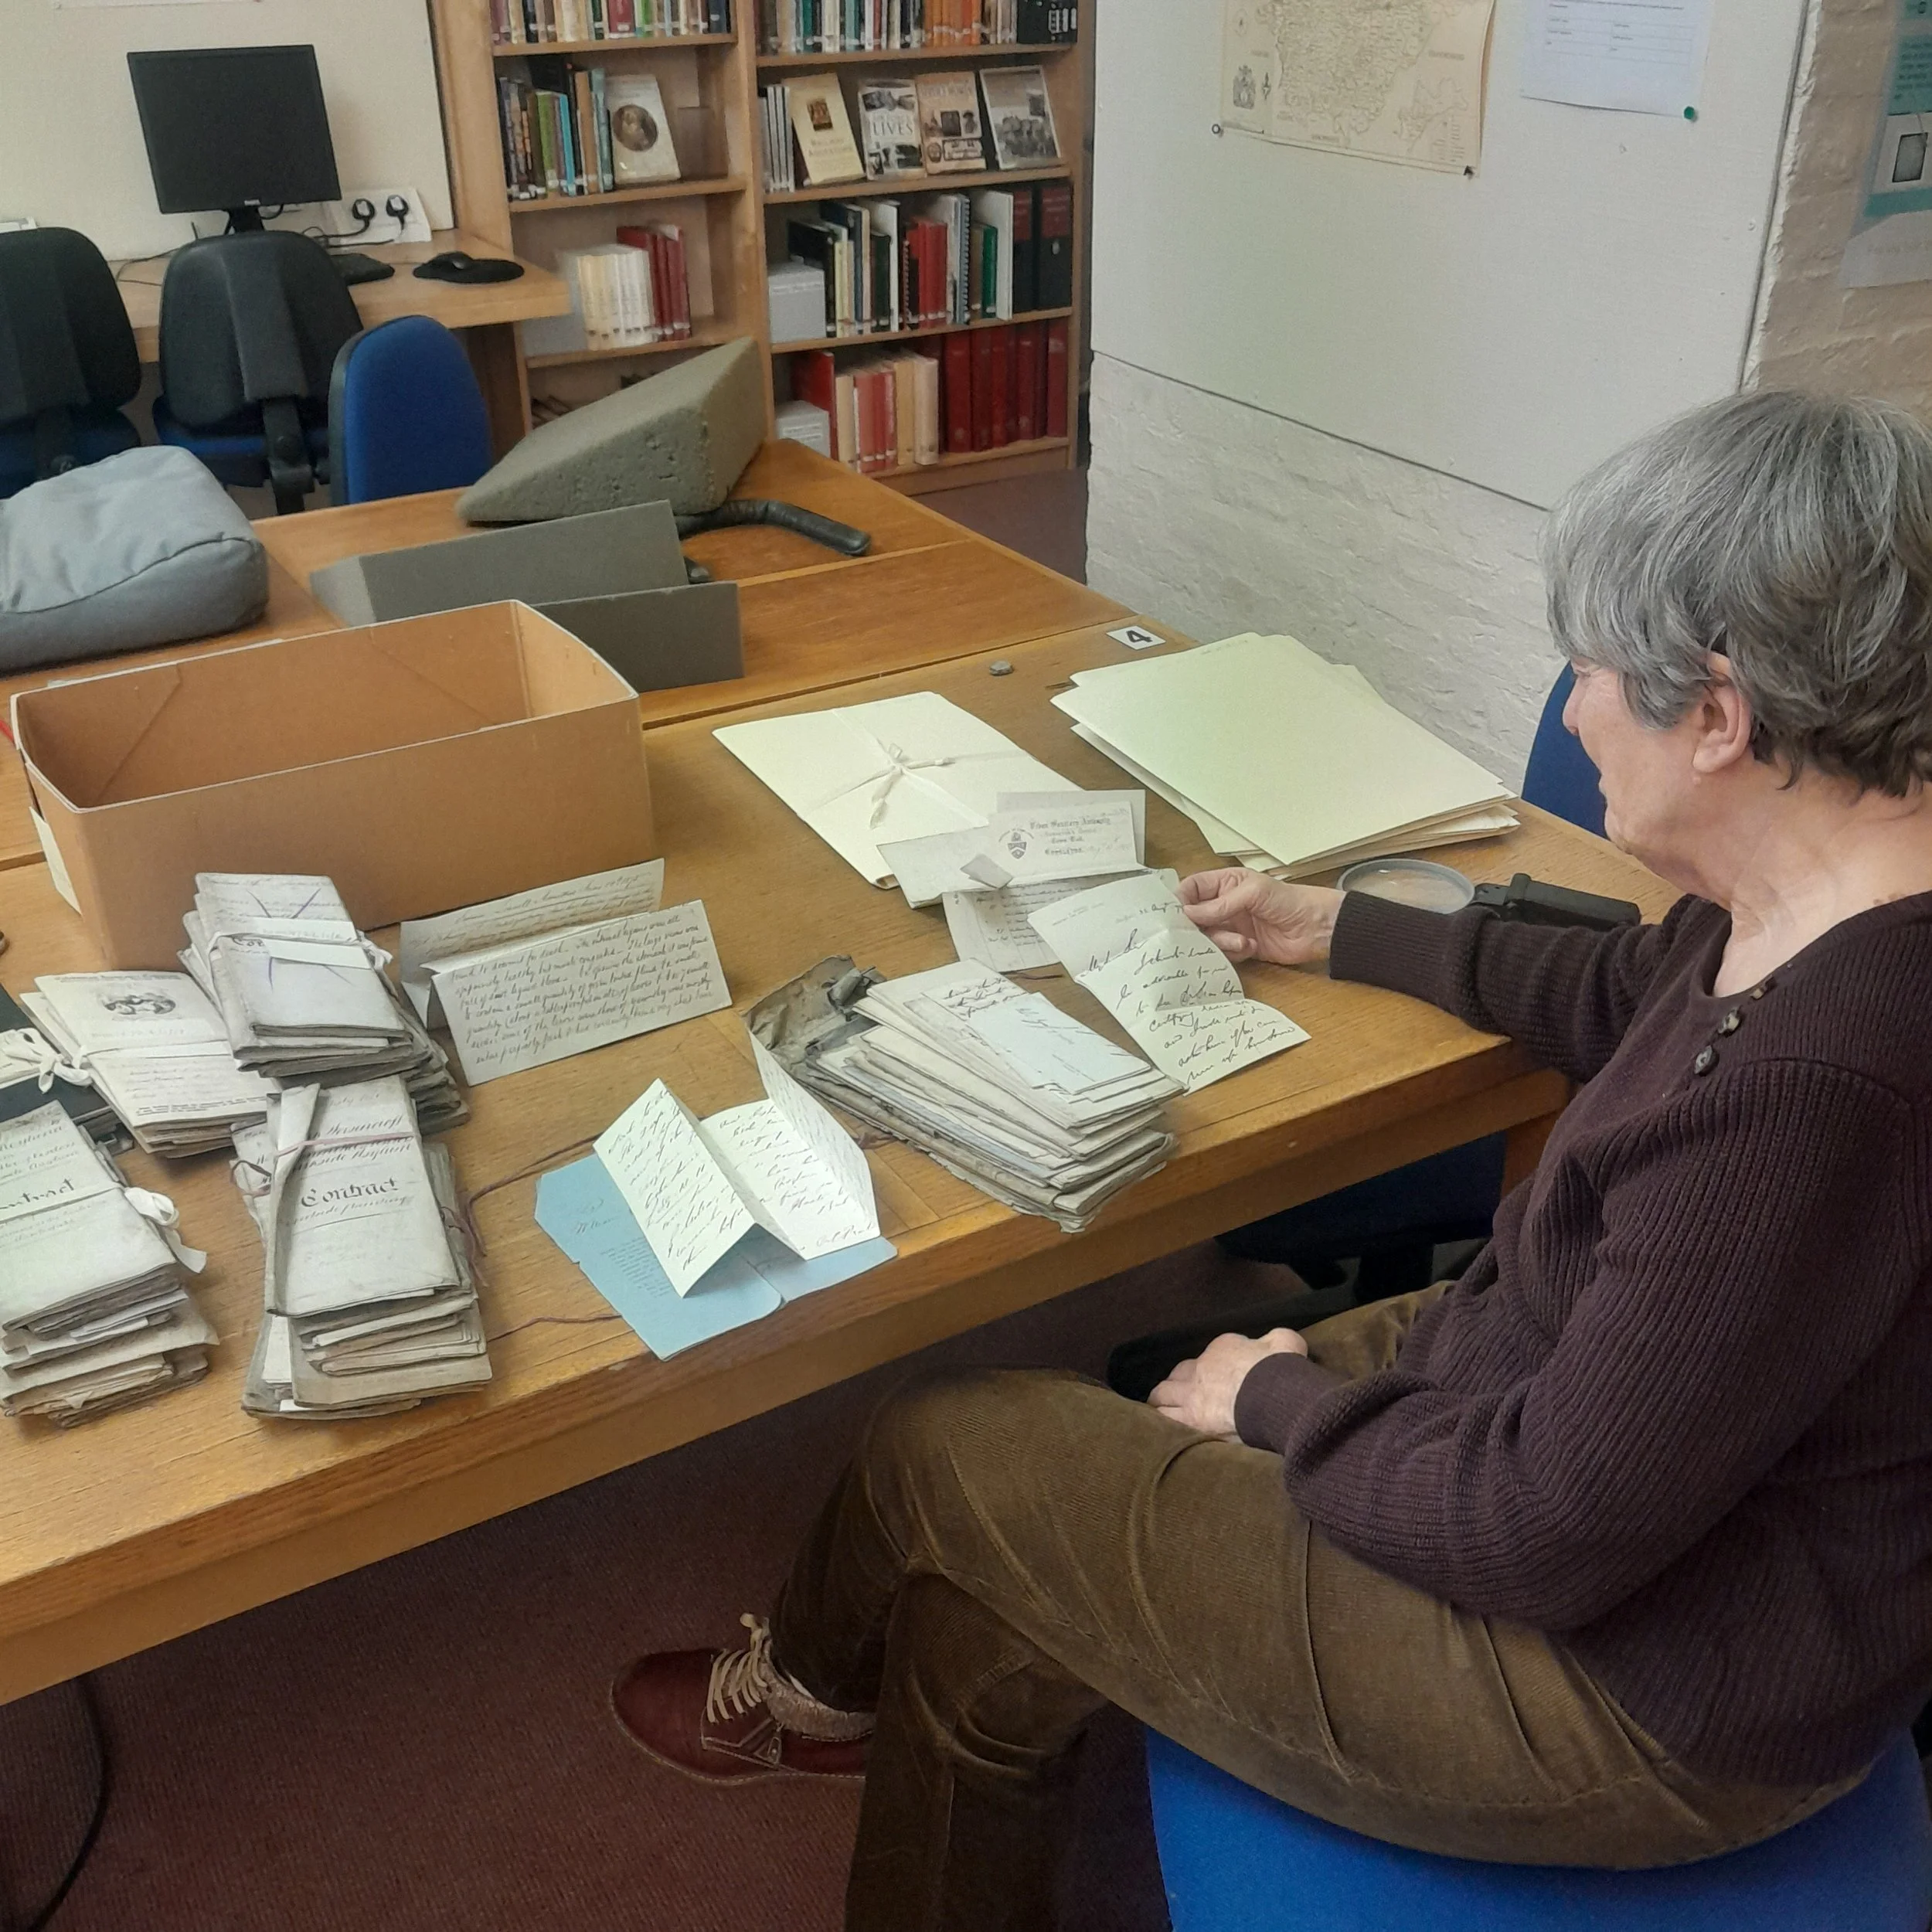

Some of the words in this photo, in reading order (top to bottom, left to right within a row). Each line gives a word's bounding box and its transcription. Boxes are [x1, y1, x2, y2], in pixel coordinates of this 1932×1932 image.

[873, 121, 913, 136] LIVES
[1126, 630, 1153, 643] 4
[301, 1177, 398, 1207] Contract
